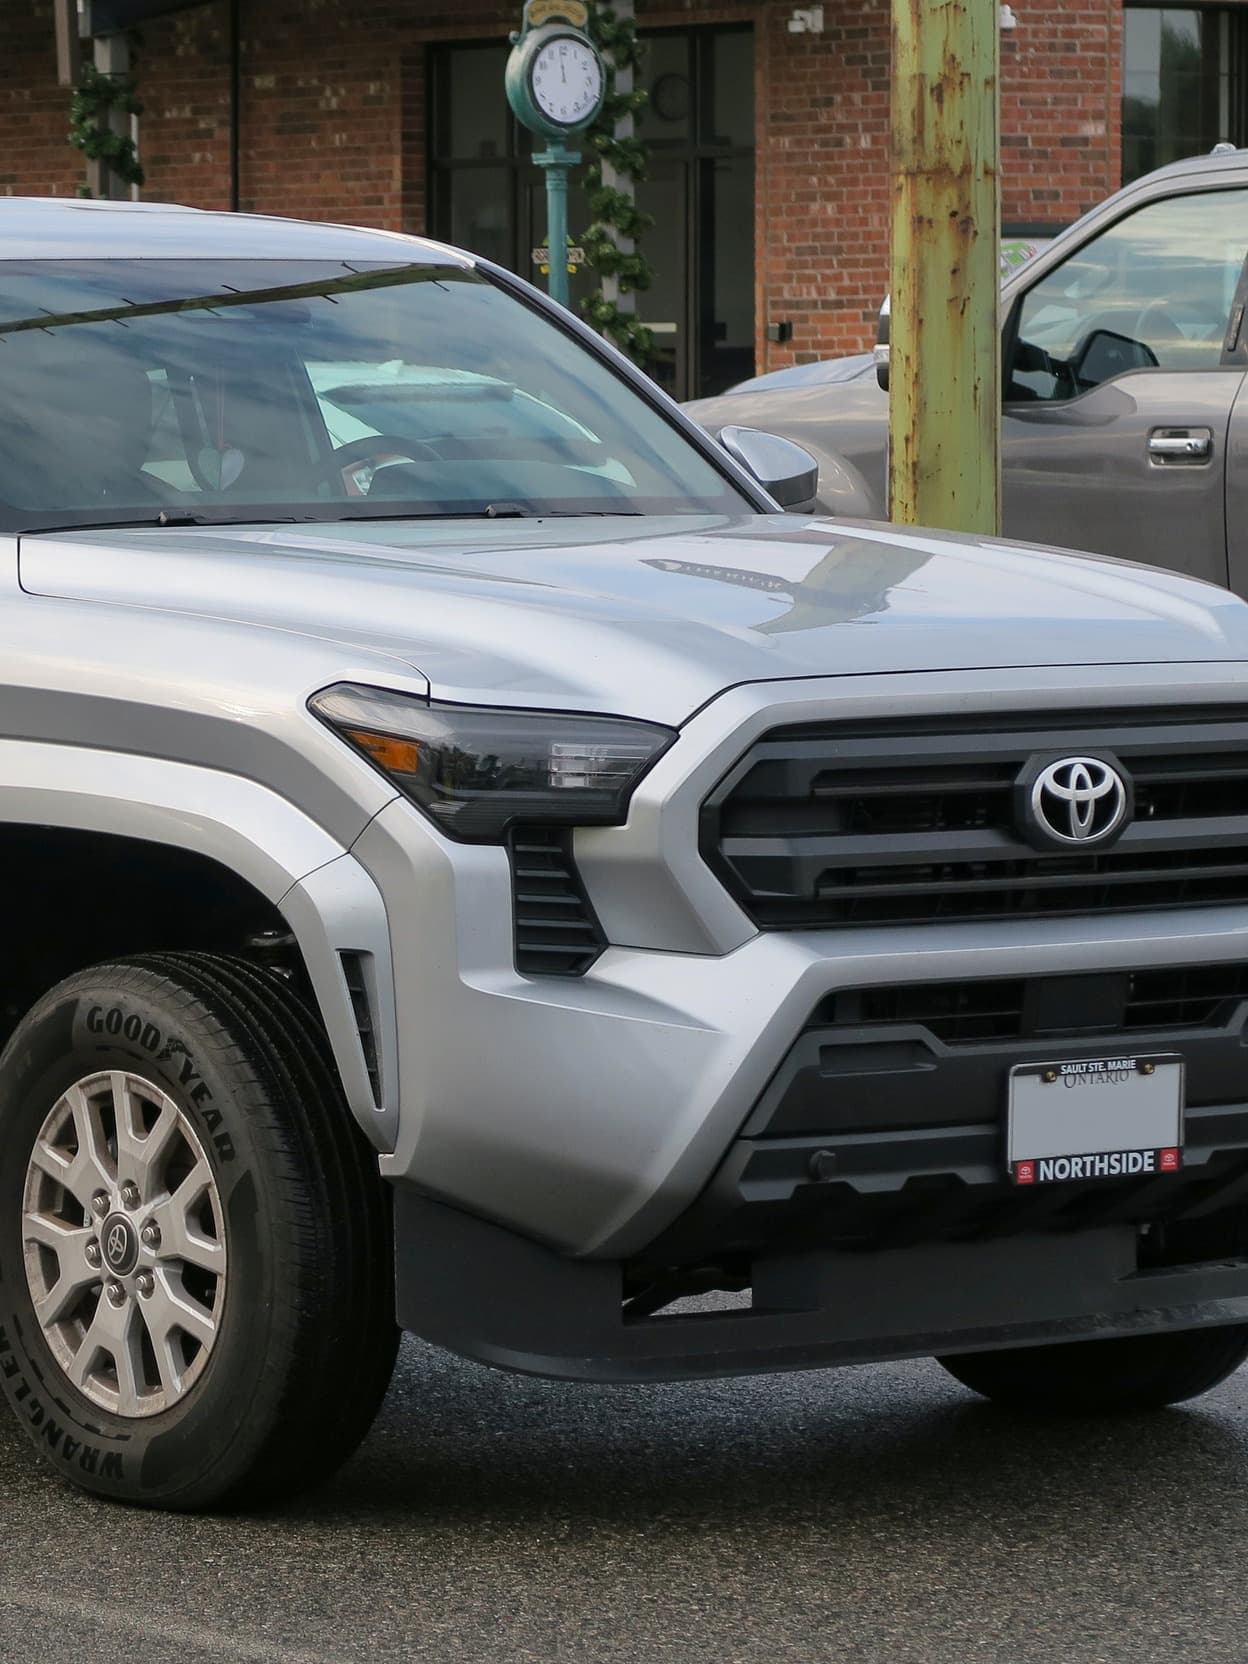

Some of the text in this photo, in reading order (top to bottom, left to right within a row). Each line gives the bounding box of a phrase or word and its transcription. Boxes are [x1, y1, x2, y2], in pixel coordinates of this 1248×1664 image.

[1060, 1059, 1137, 1075] SAULT STE. MARIE
[87, 1006, 236, 1163] GOODYEAR
[1039, 1151, 1155, 1182] NORTHSIDE
